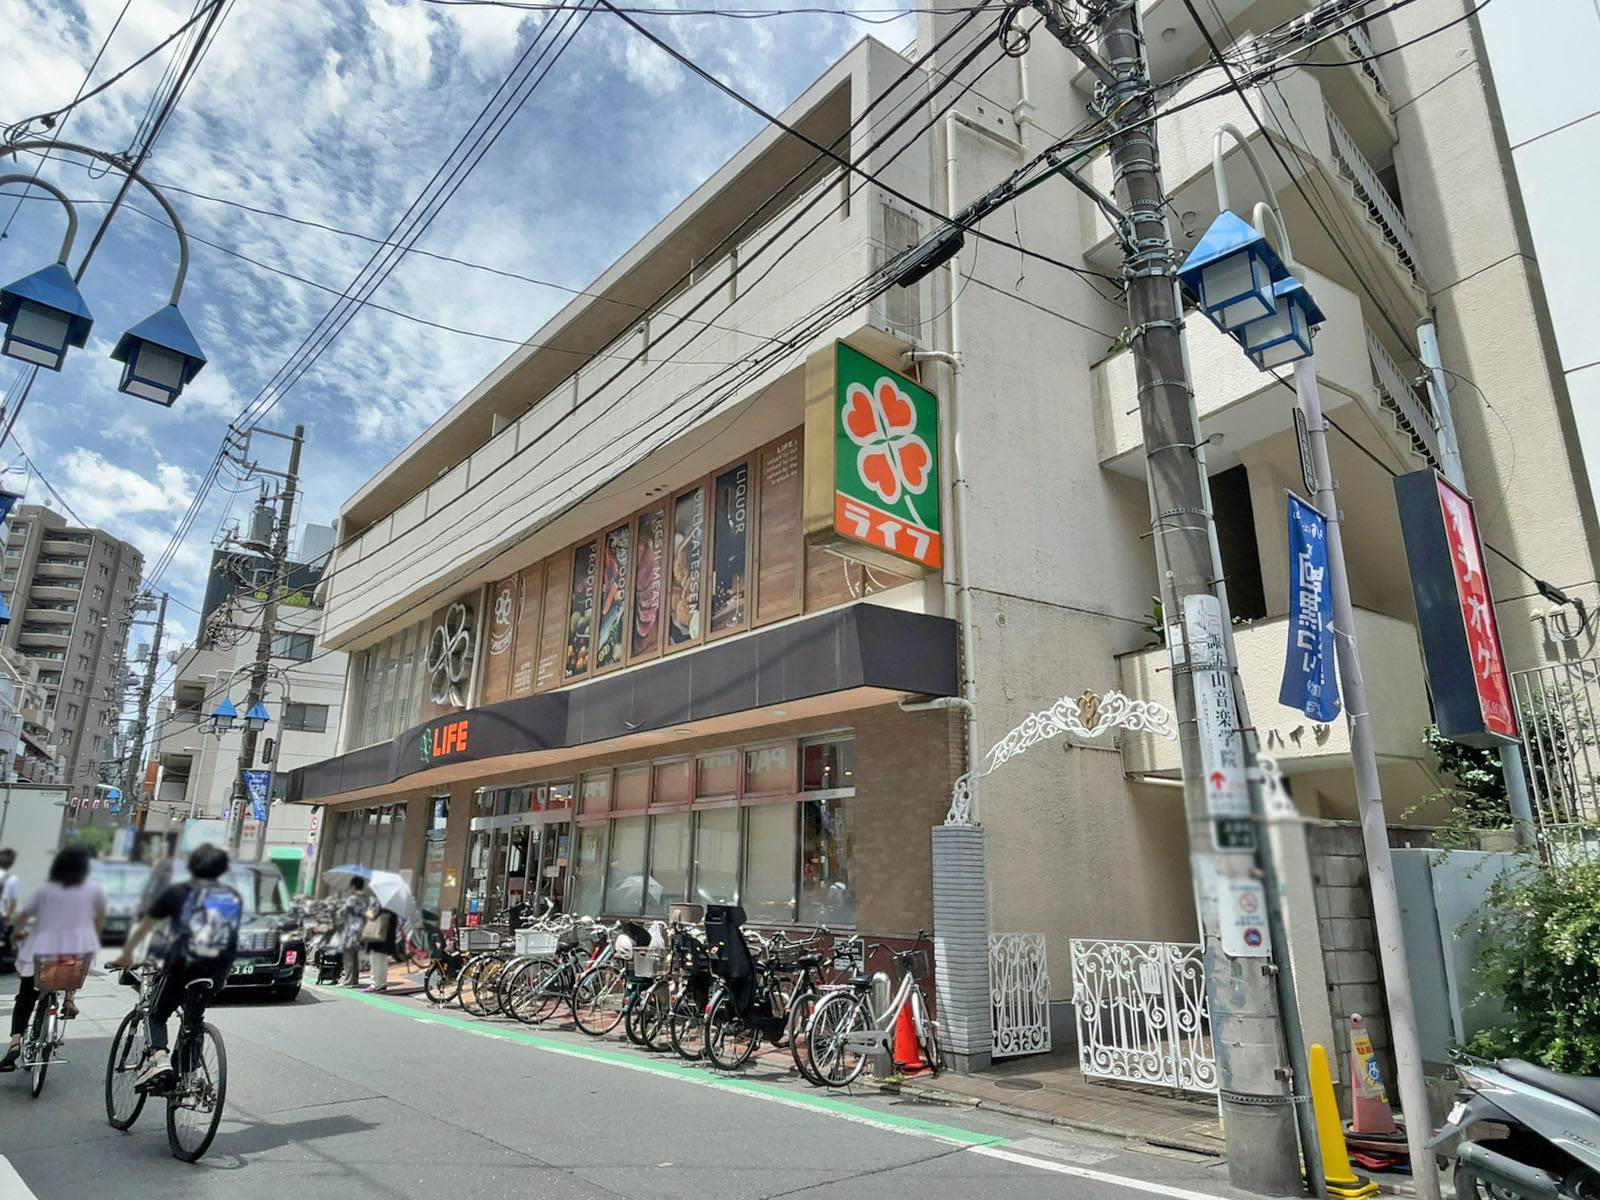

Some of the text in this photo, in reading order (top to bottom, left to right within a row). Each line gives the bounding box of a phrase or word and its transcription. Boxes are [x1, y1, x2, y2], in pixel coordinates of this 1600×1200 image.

[735, 469, 746, 535] LIQUOR
[845, 502, 930, 560] ライフ
[584, 543, 597, 617] PRODUCE
[651, 509, 664, 609] FRESH MEAT
[688, 490, 704, 615] DELICATESSEN
[433, 720, 468, 757] LIFE
